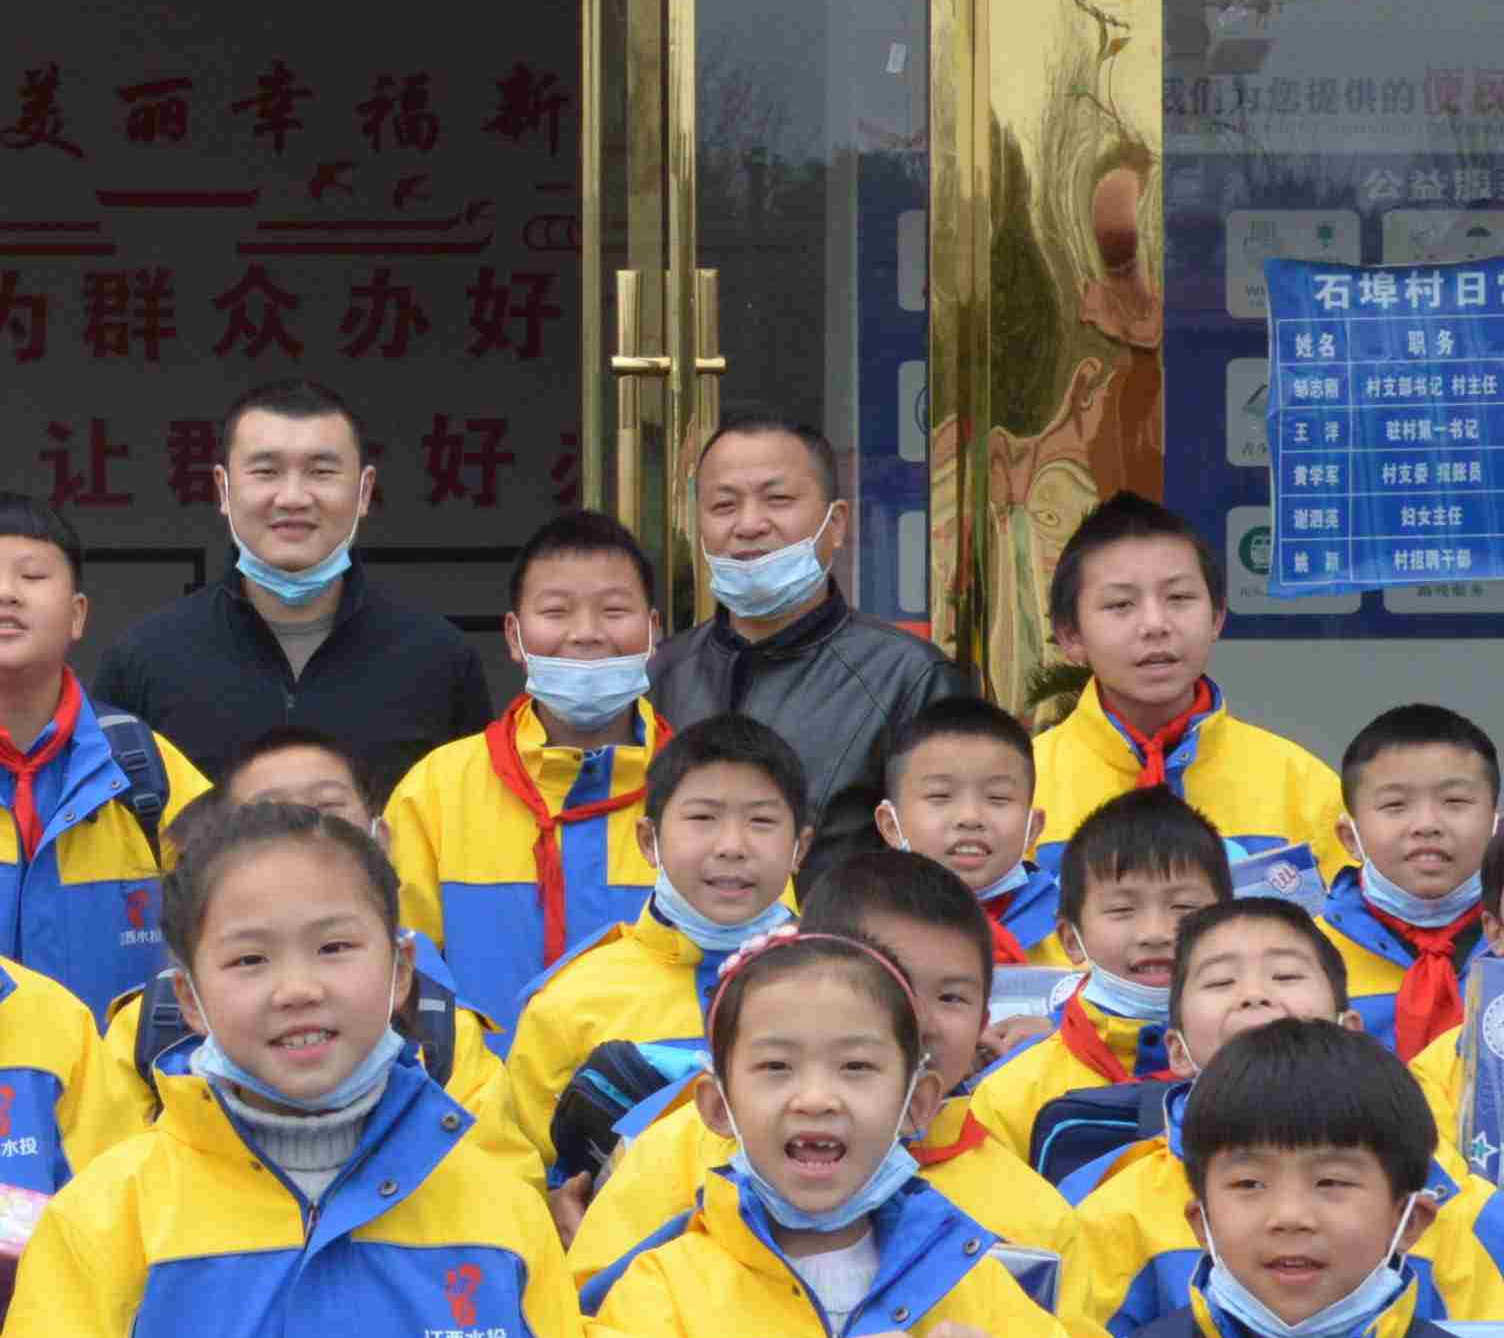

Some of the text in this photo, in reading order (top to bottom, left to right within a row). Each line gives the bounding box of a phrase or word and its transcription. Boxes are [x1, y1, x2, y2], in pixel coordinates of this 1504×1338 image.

[1295, 333, 1336, 358] 姓名
[1407, 329, 1455, 356] 职务
[1366, 374, 1498, 398] 村支部书记 村主任
[1386, 418, 1480, 441] 驻村第一书记
[1294, 465, 1340, 487] 黄学军
[1382, 462, 1429, 485] 村支委
[1401, 505, 1464, 527] 妇女主任
